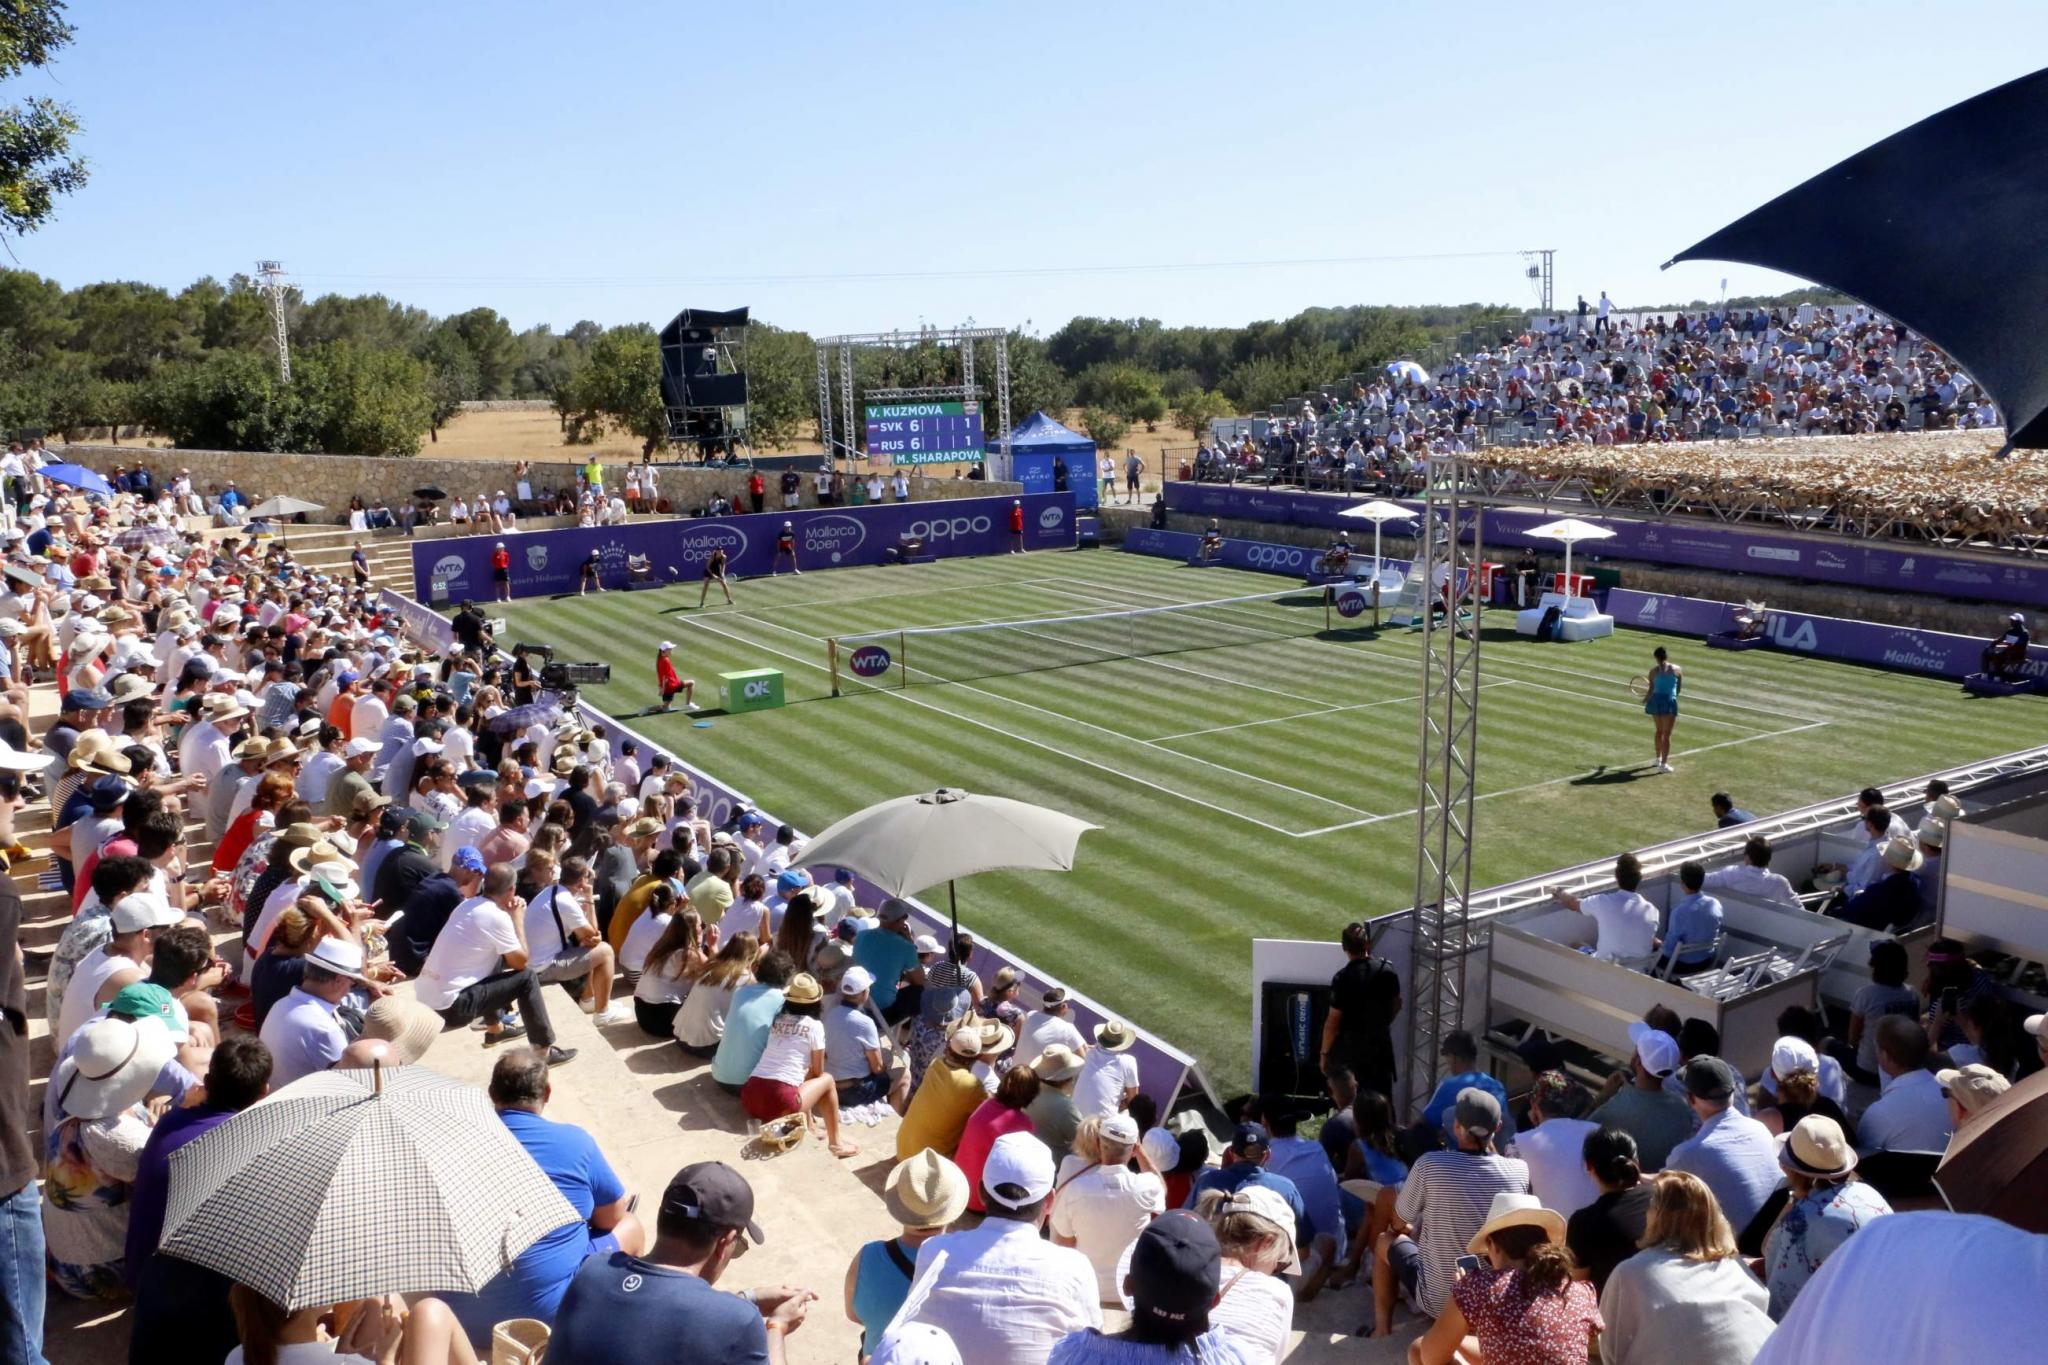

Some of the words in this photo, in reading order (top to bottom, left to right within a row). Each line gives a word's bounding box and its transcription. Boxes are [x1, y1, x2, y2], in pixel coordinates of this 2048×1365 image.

[869, 408, 880, 417] V.
[883, 405, 943, 417] KUZMOVA
[880, 422, 903, 432] SVK
[909, 419, 920, 432] 6
[964, 417, 970, 428] 1
[881, 440, 904, 451] RUS
[910, 437, 920, 450] 6
[965, 435, 971, 446] 1
[896, 454, 909, 464] M.
[912, 450, 981, 463] SHARAPOVA
[1043, 512, 1062, 522] WTA
[805, 525, 856, 539] Mallorca
[909, 515, 991, 542] oppo
[683, 535, 737, 549] Mallorca
[805, 538, 840, 552] Open
[683, 549, 716, 562] Ope
[1247, 546, 1303, 568] oppo
[435, 563, 462, 573] WTA
[432, 582, 447, 591] 0:52
[1338, 599, 1364, 610] WTA
[1766, 613, 1818, 650] ILA
[852, 654, 889, 669] WTA
[1883, 649, 1945, 670] Mallorca
[743, 680, 772, 698] OK
